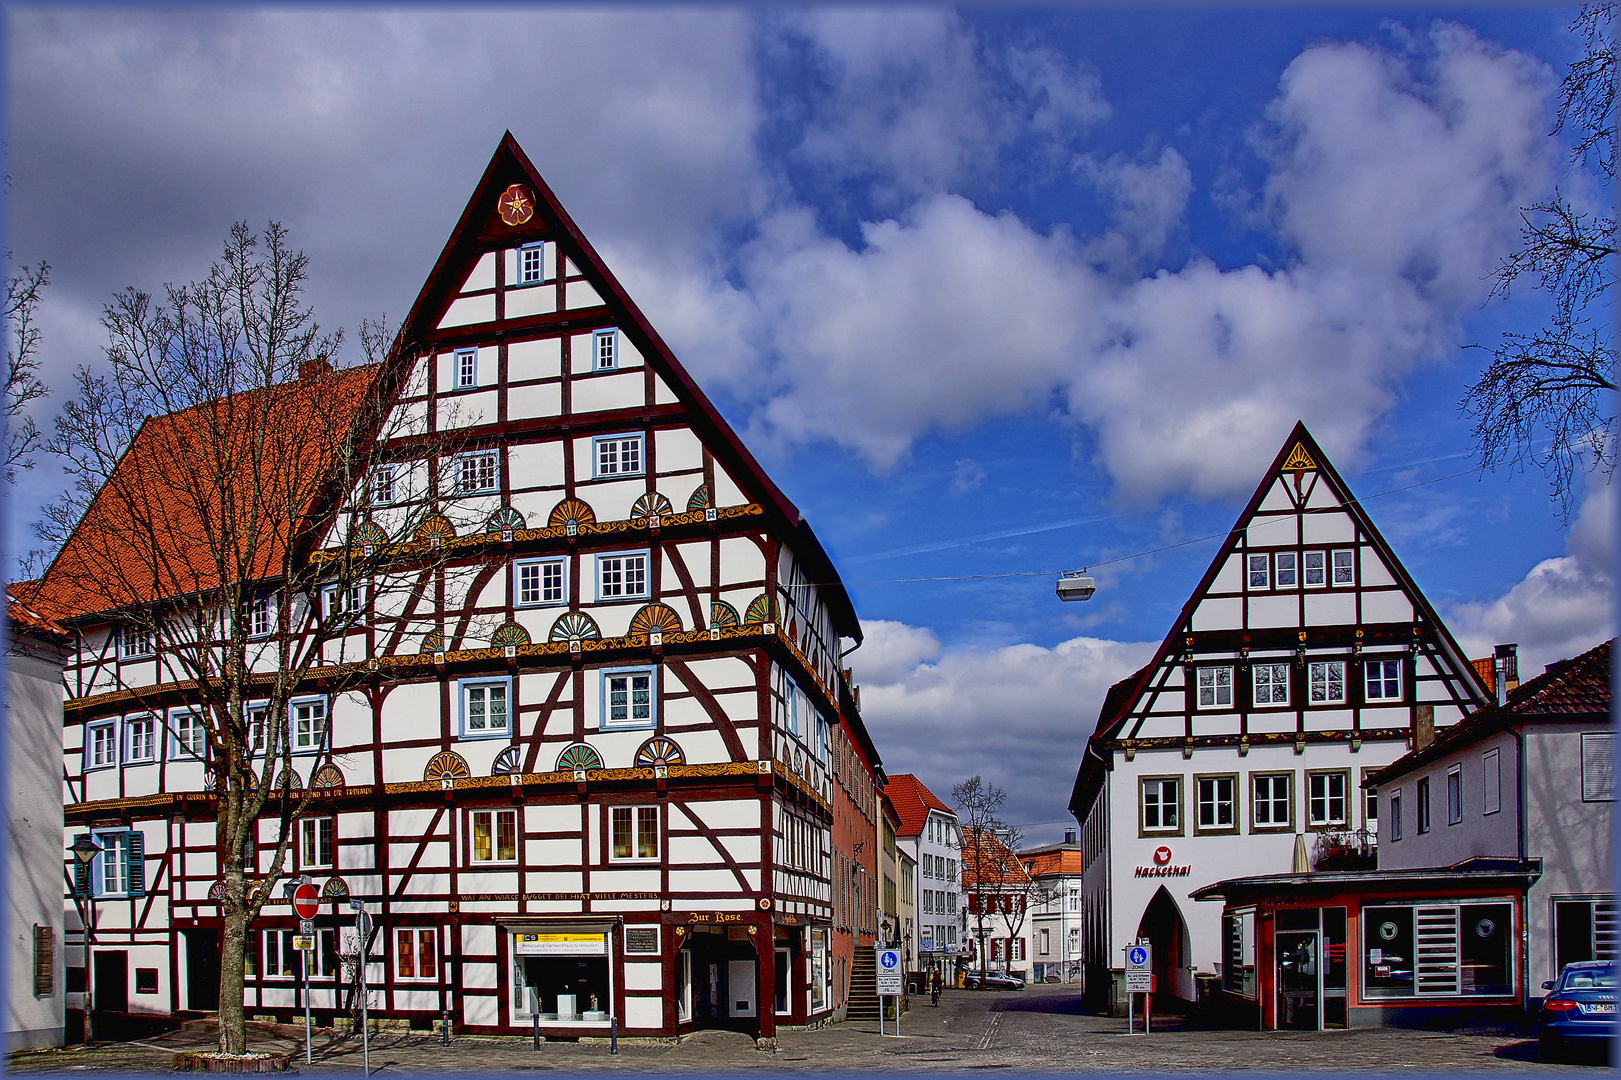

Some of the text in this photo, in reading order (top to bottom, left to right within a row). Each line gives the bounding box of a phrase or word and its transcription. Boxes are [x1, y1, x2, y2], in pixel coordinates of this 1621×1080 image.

[1134, 864, 1192, 877] Hackethal
[594, 892, 617, 900] VIELE
[687, 911, 710, 923] Zur
